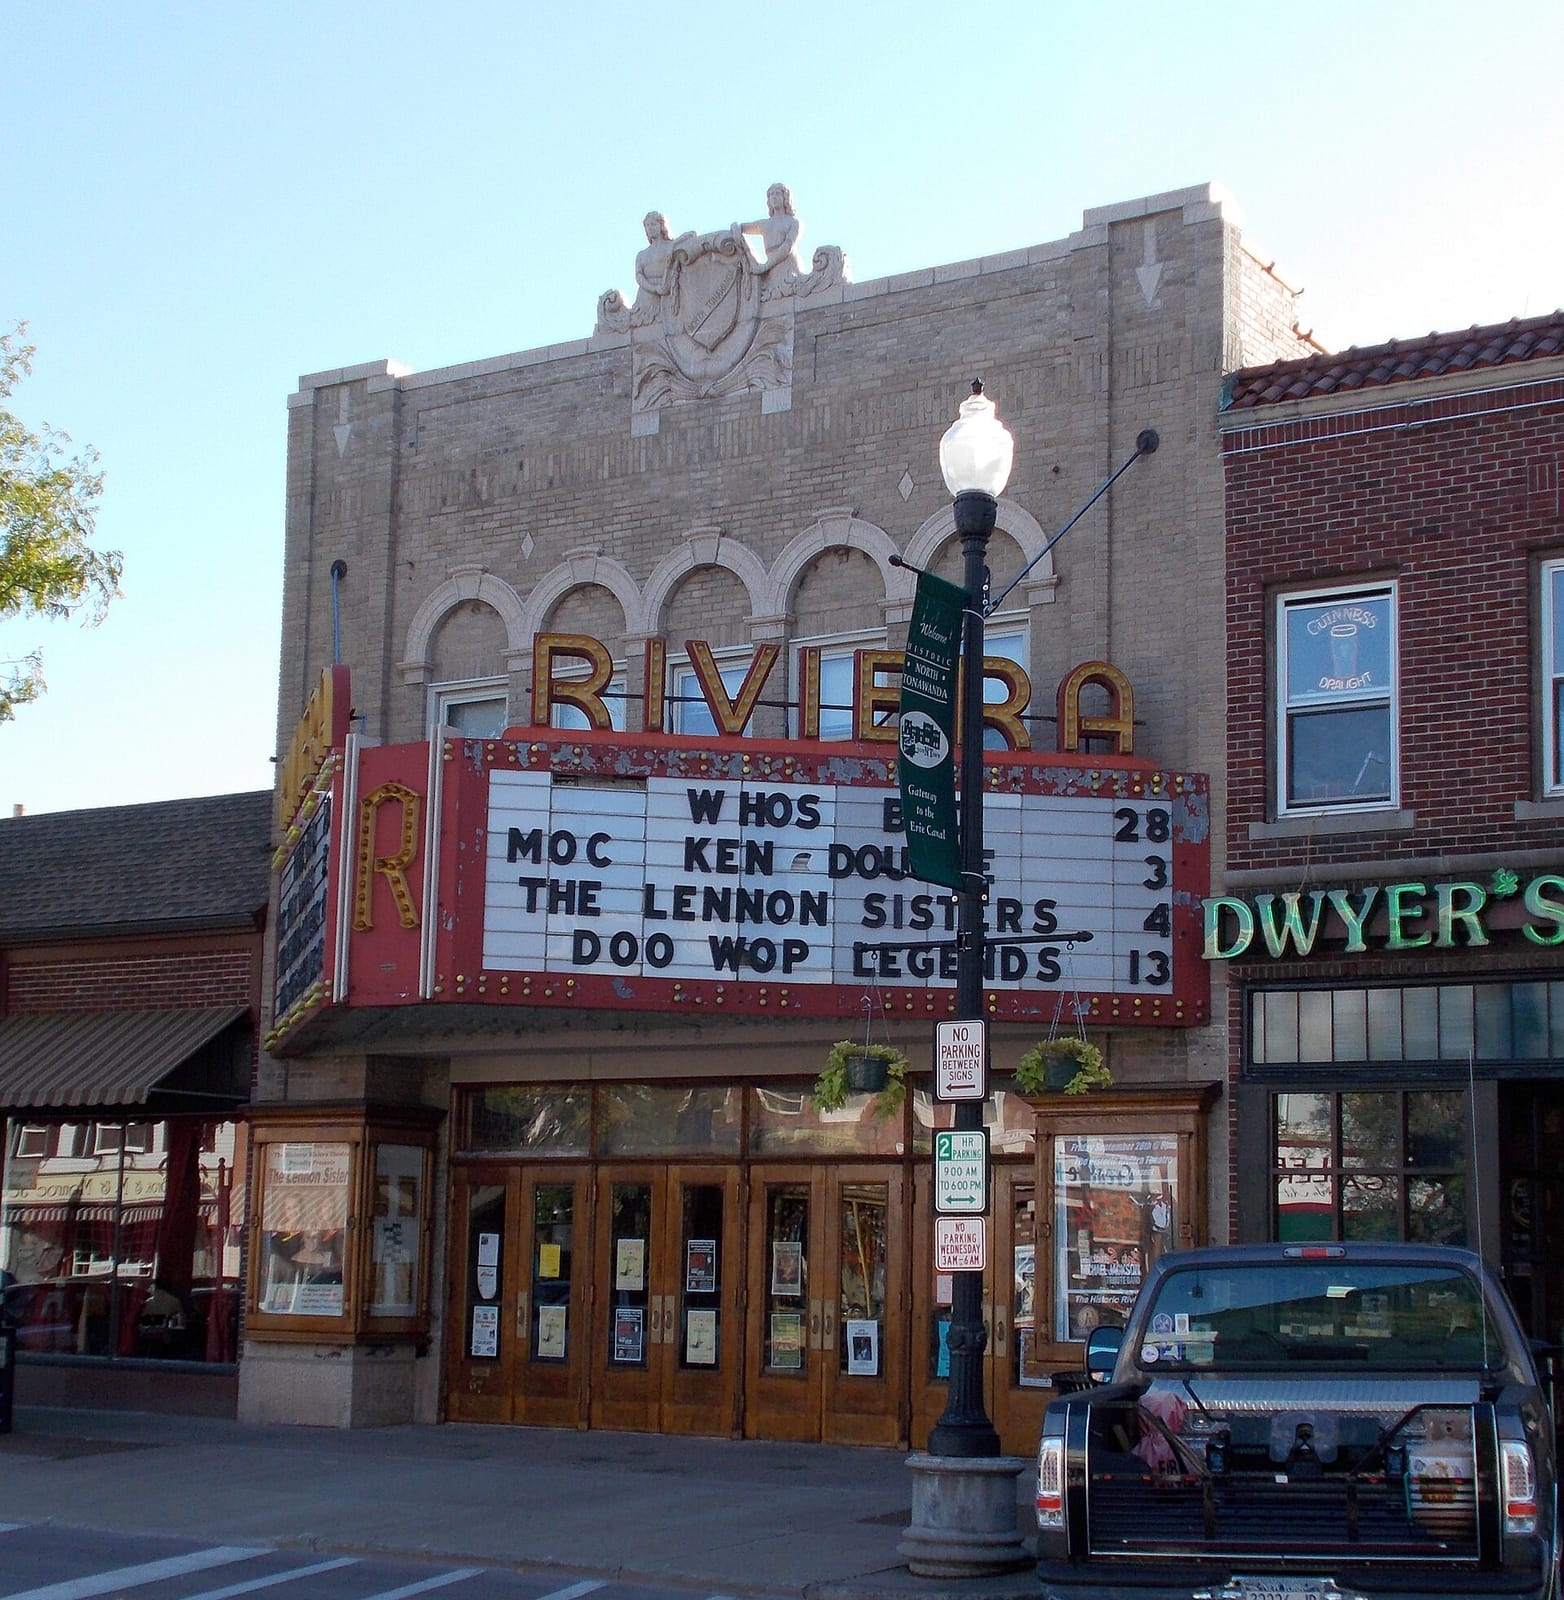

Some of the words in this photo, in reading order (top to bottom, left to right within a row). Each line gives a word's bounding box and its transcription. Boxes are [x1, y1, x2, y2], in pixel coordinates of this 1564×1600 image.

[1306, 607, 1378, 636] GUINNESS
[907, 642, 953, 667] HISTORIC
[914, 662, 940, 681] NORTH
[902, 673, 949, 699] TONAWANDA
[1318, 671, 1372, 690] DRAUGHT
[907, 783, 937, 804] Gateway
[916, 805, 924, 816] to
[924, 806, 936, 819] the
[910, 820, 926, 834] Erie
[926, 824, 946, 840] Canal
[1114, 807, 1170, 843] 28
[352, 783, 421, 931] R
[507, 827, 612, 868] MOC
[684, 836, 774, 876] KEN
[1143, 856, 1168, 890] 3
[518, 876, 601, 916] THE
[642, 883, 828, 927] LENNON
[1143, 902, 1171, 938] 4
[572, 929, 675, 968] DOO
[708, 934, 809, 975] WOP
[1129, 948, 1170, 986] 13
[952, 1027, 969, 1042] NO
[941, 1043, 981, 1059] PARKING
[942, 1059, 980, 1070] BETWEEN
[949, 1070, 973, 1081] SIGNS
[939, 1138, 950, 1157] 2
[961, 1137, 974, 1147] HR
[952, 1149, 982, 1159] PARKING
[965, 1166, 977, 1177] AM
[940, 1180, 950, 1191] TO
[970, 1180, 981, 1190] PM
[955, 1222, 965, 1232] NO
[944, 1233, 977, 1244] PARKING
[940, 1244, 981, 1255] WEDNESDAY
[942, 1255, 980, 1266] 3AM-6AM
[1075, 1295, 1089, 1304] The
[1090, 1295, 1120, 1304] Historic
